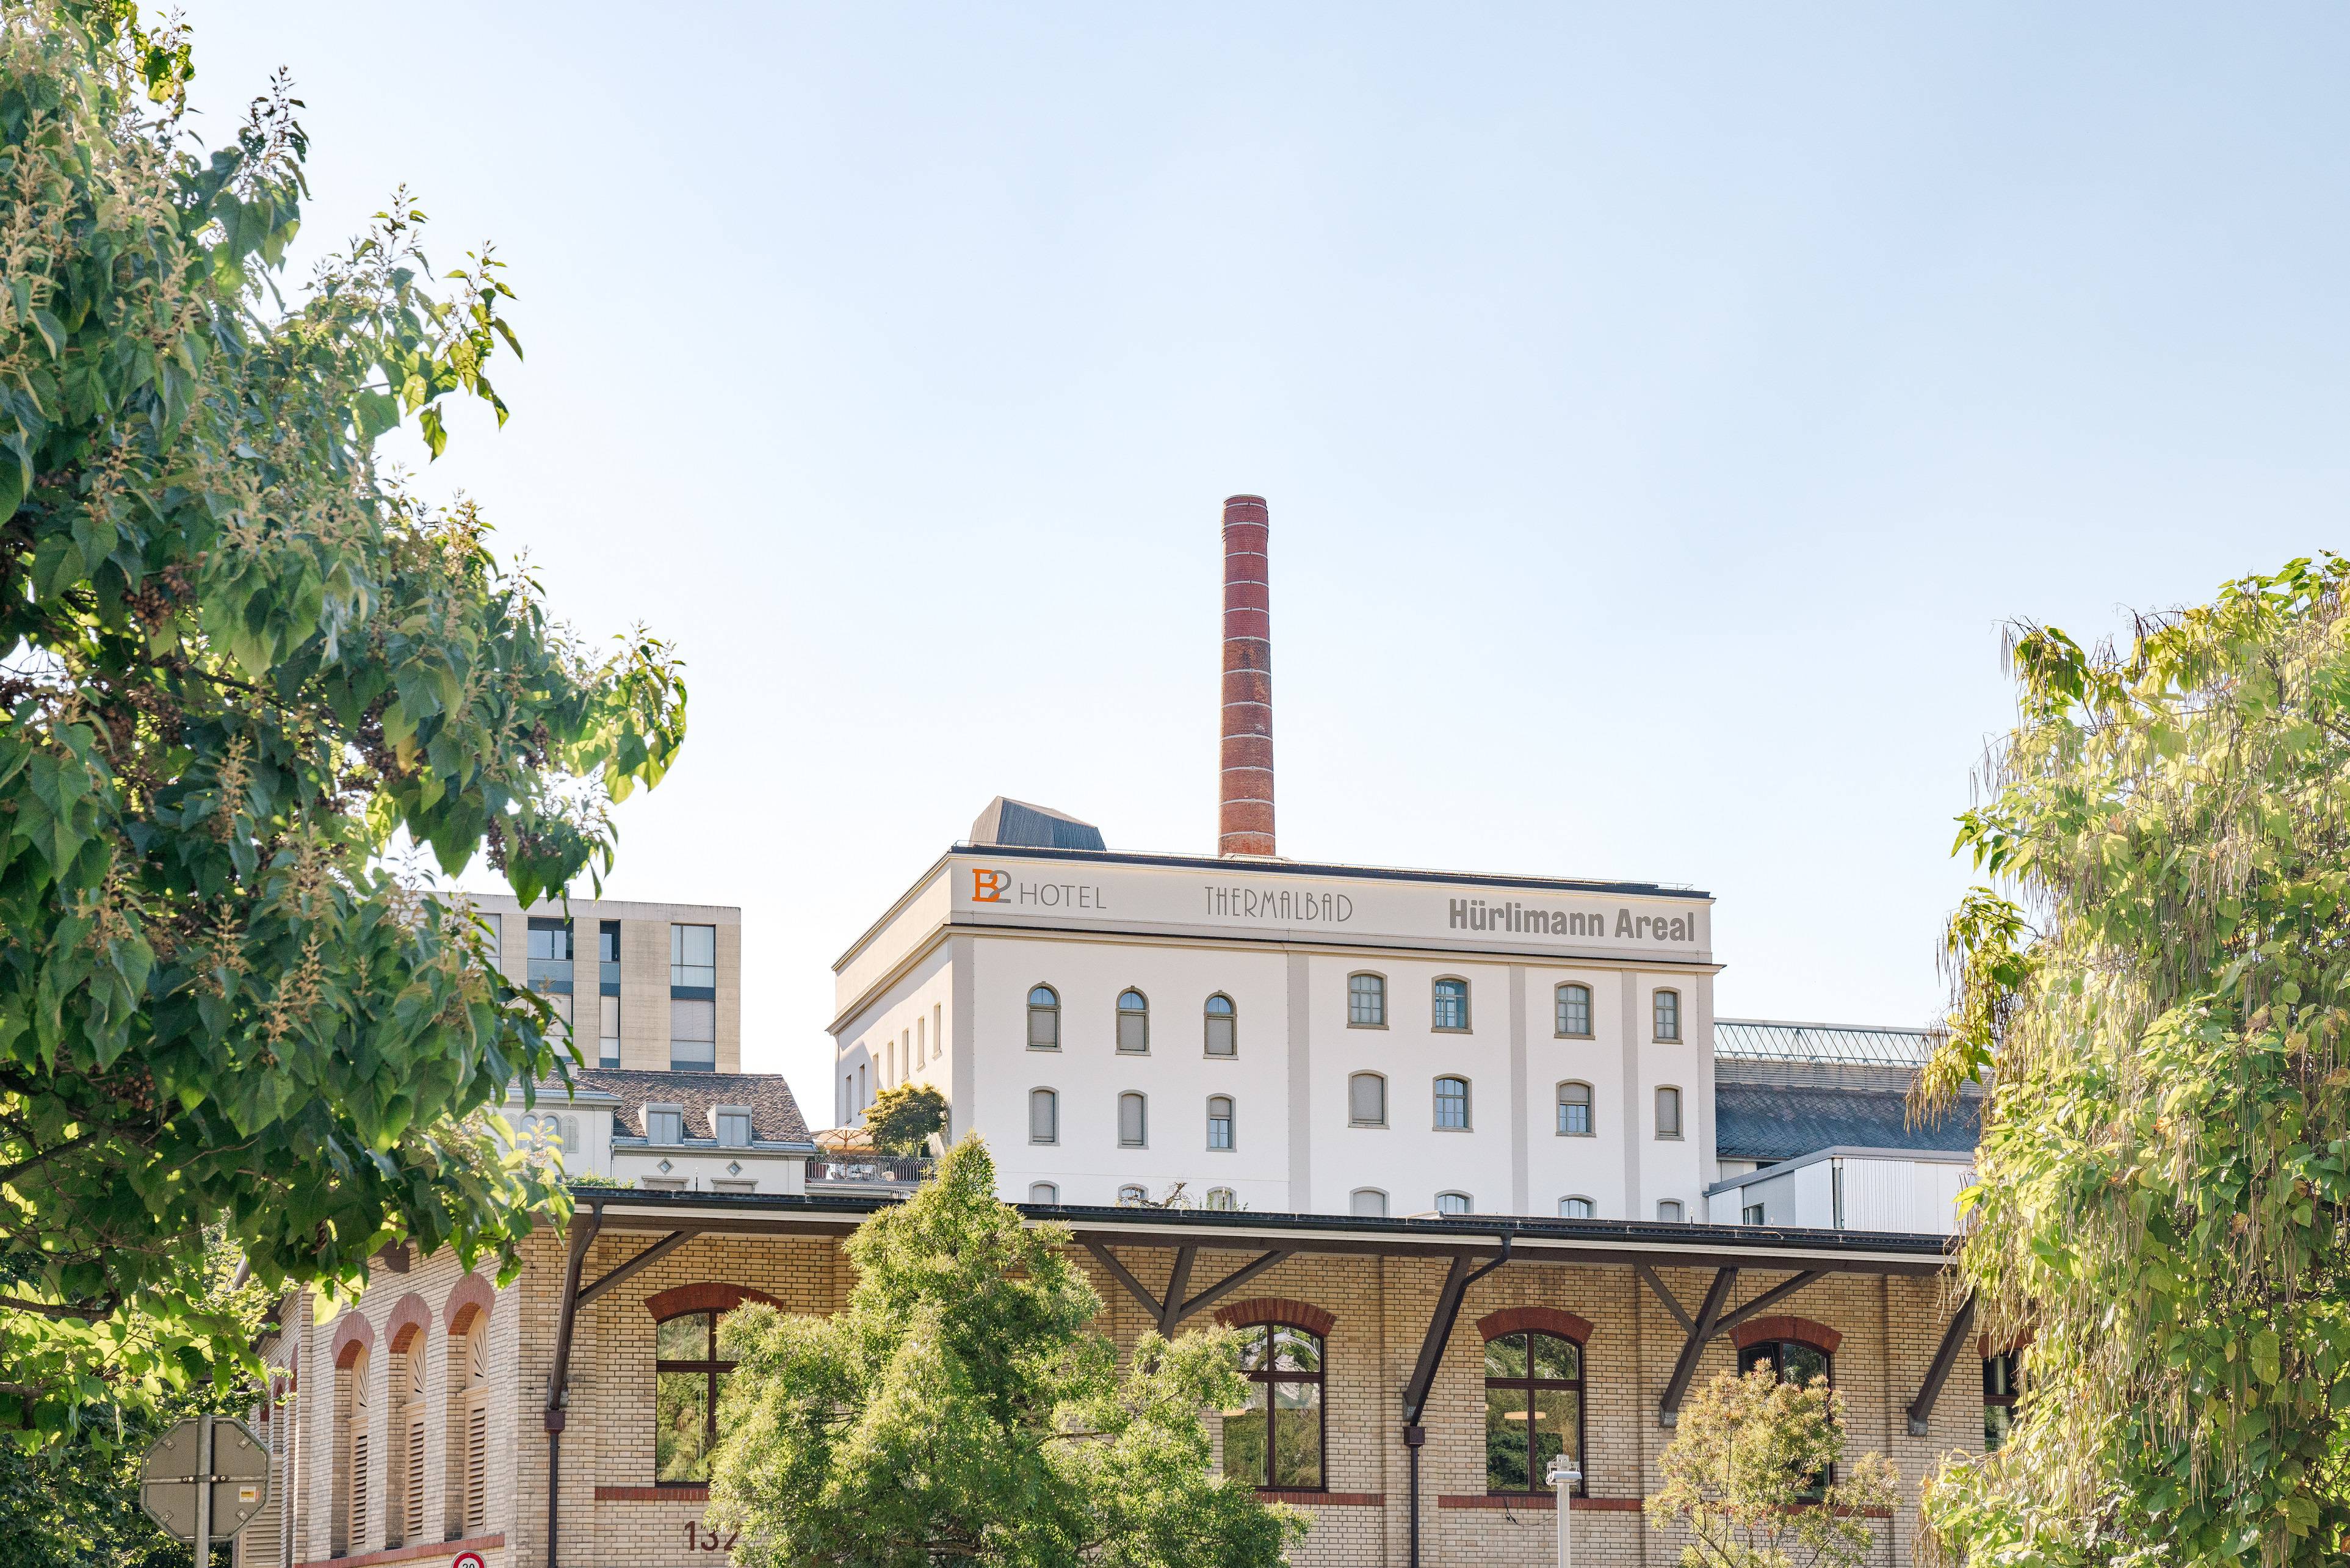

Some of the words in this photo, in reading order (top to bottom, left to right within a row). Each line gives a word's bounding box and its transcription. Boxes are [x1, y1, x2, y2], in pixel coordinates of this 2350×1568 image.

[972, 869, 1012, 903] B2
[1020, 883, 1107, 909] HOTEL
[1204, 886, 1353, 922] THERMALBAD
[1449, 898, 1605, 937] Hürlimann
[1614, 908, 1694, 942] Areal
